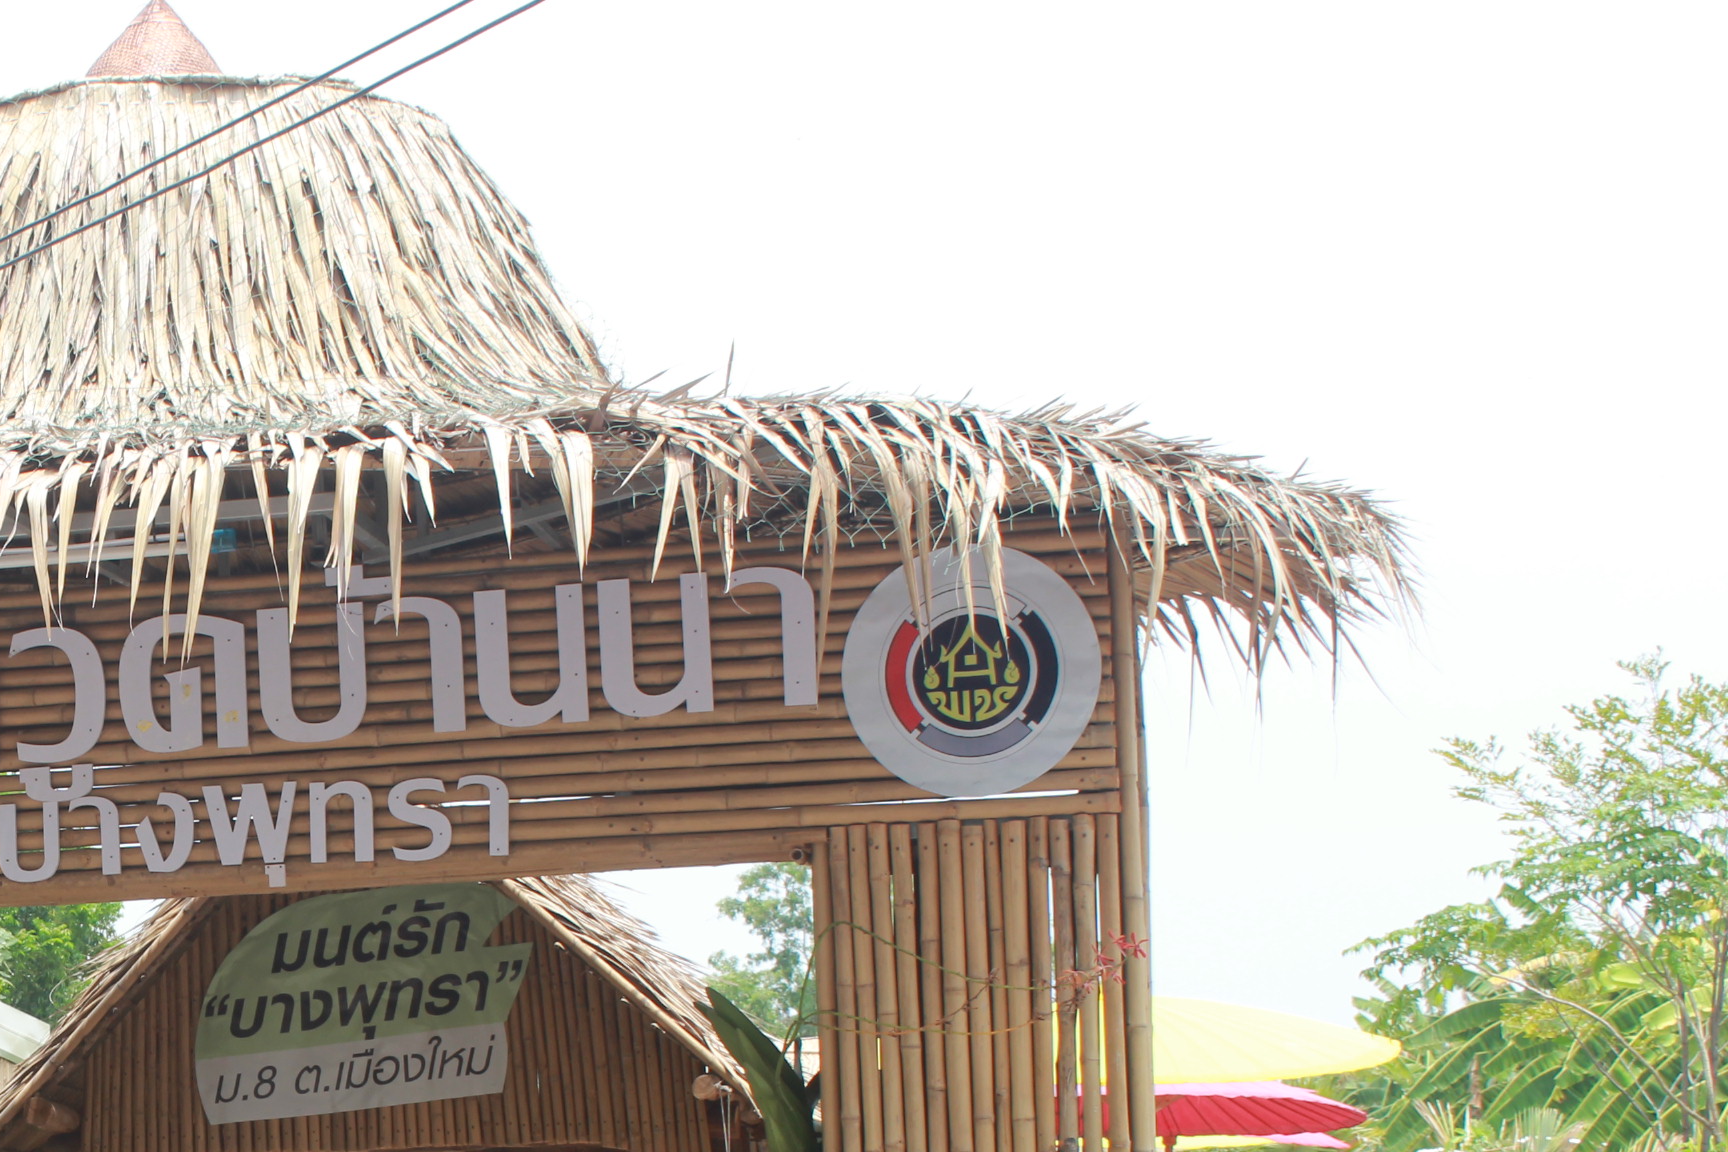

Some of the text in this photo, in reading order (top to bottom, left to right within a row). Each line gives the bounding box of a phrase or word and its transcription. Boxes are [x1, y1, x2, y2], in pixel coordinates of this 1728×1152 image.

[272, 898, 471, 975] มนต์รัก
[214, 1034, 496, 1105] ม.8 ต.เมืองใหม่
